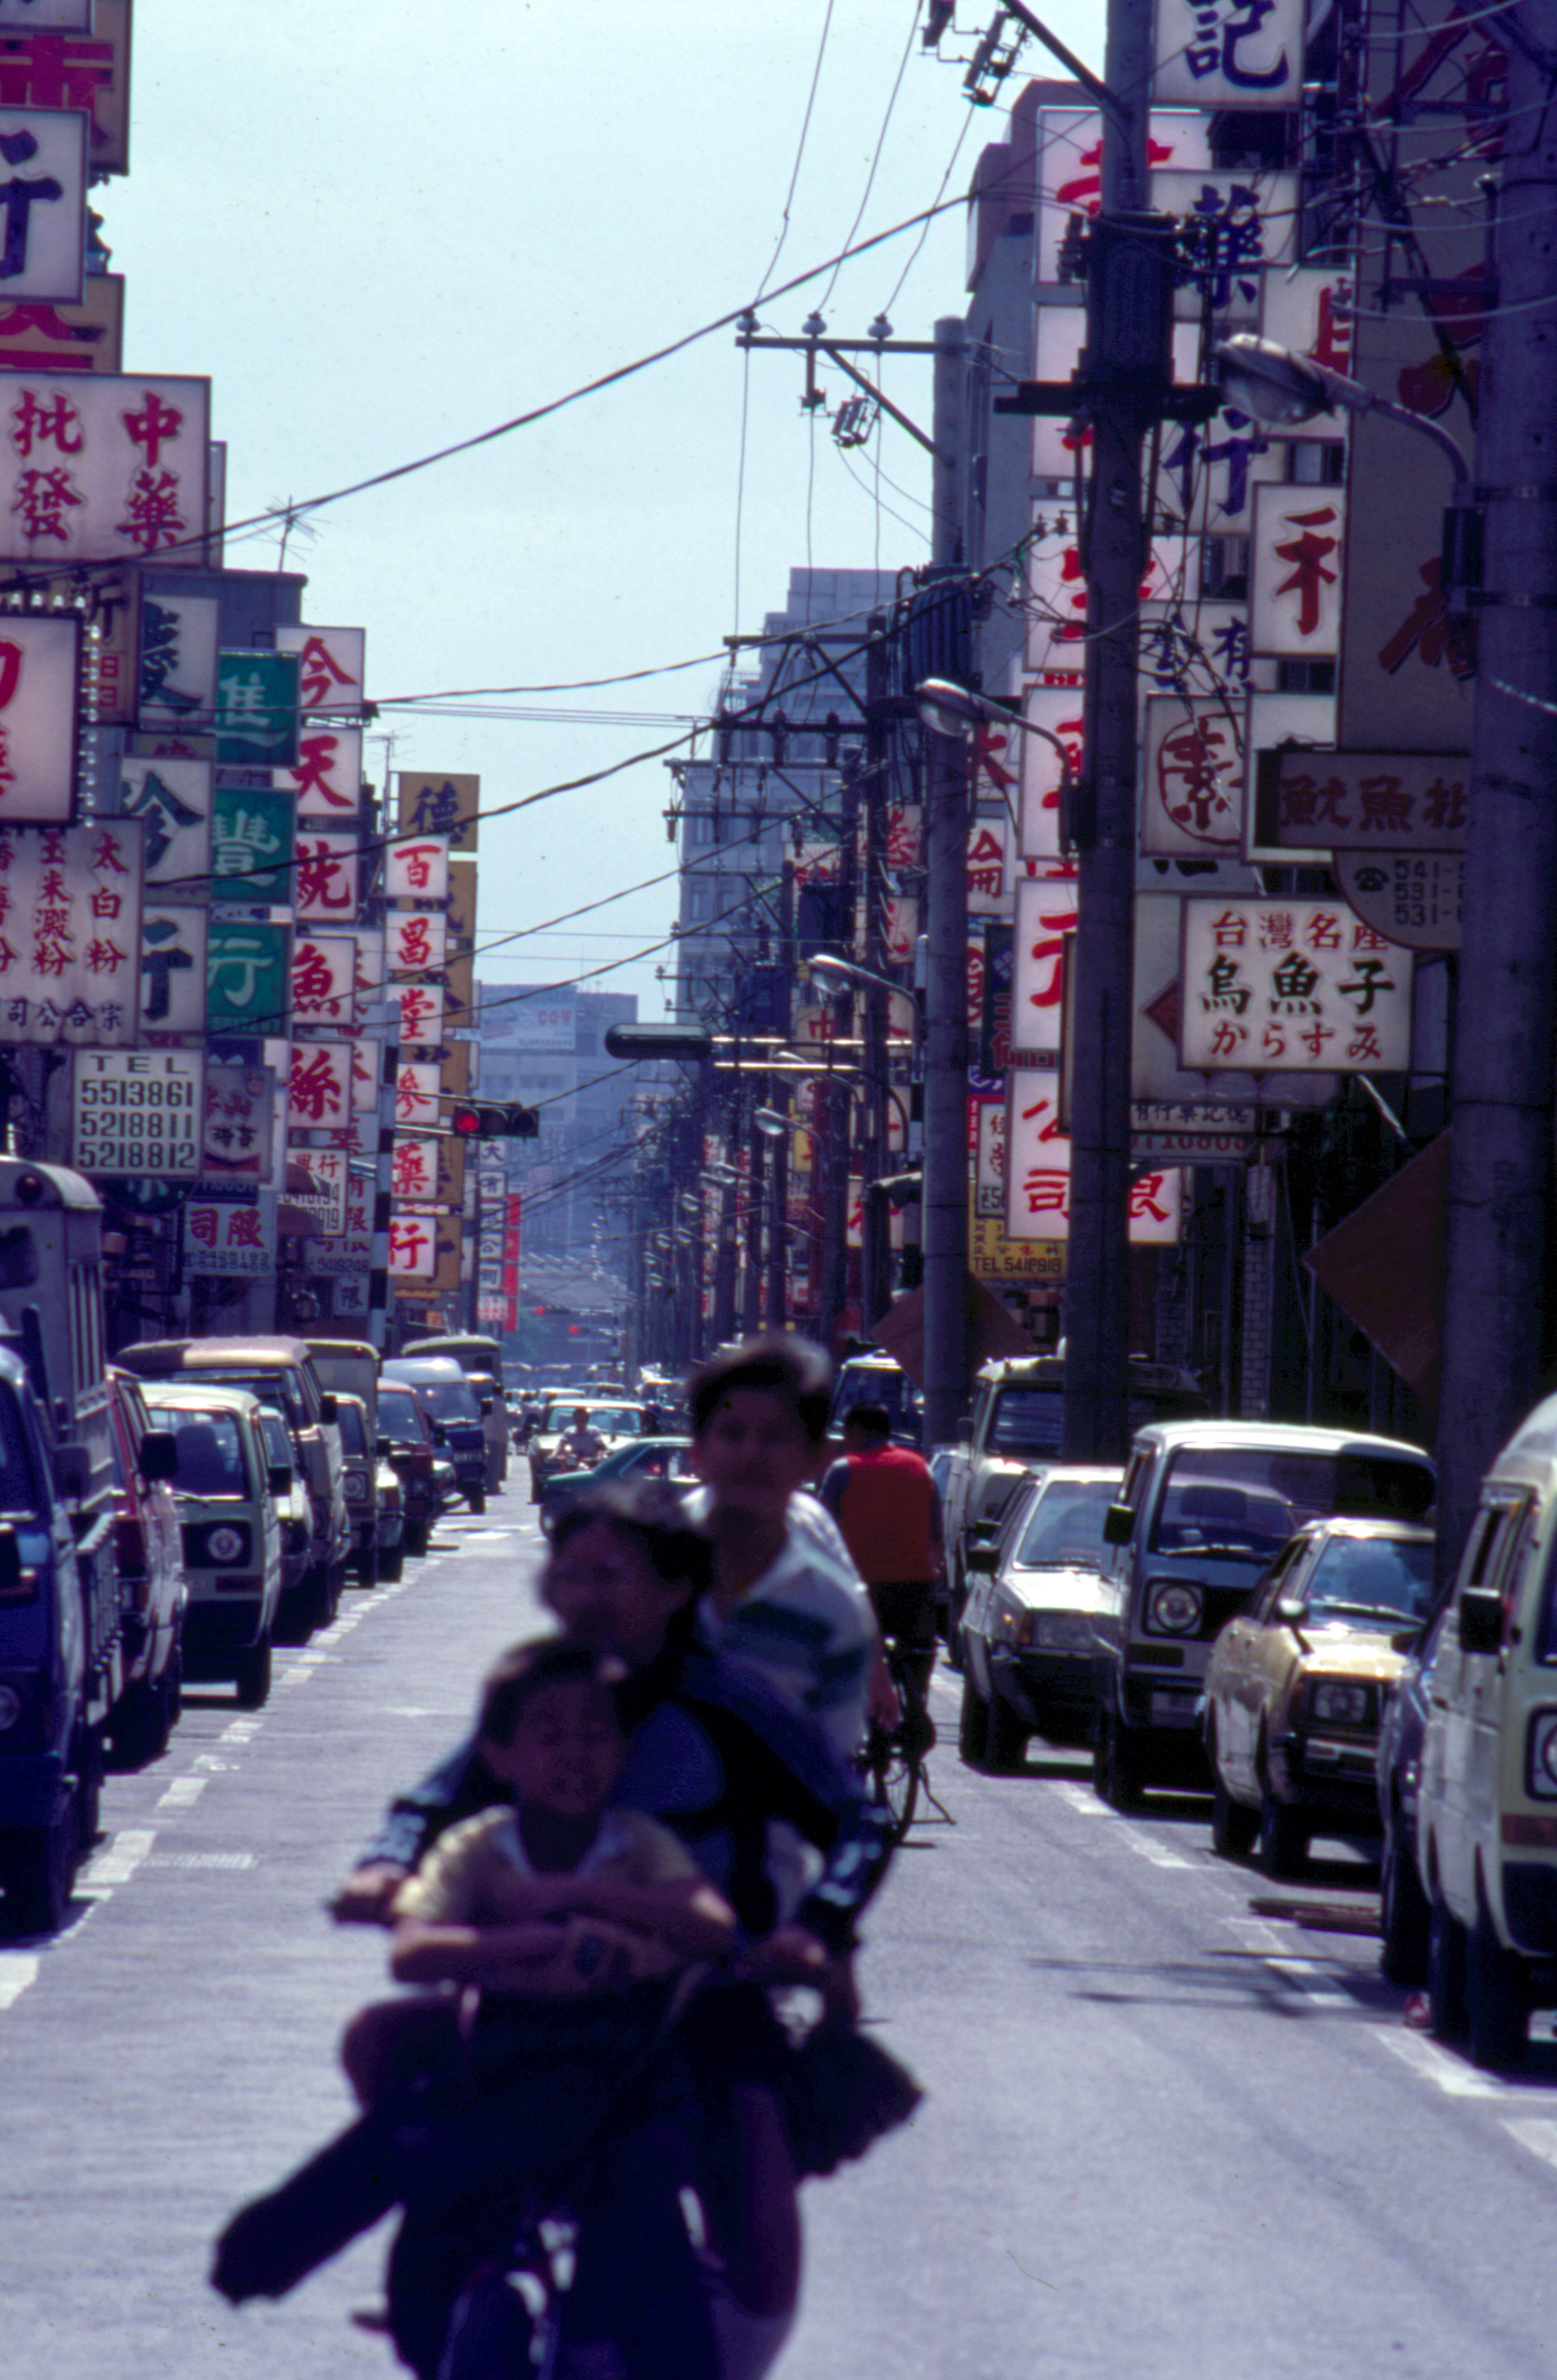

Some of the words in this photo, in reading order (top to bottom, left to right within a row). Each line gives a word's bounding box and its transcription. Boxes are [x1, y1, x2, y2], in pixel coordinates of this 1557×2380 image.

[11, 390, 83, 541] 批發
[116, 393, 186, 551] 中藥
[91, 832, 129, 973] 太白粉
[1202, 952, 1395, 1015] 烏魚子
[1211, 1021, 1381, 1060] からすみ
[90, 1055, 189, 1074] TEL
[82, 1080, 193, 1107] 5513861
[81, 1111, 193, 1139] 5218811
[79, 1142, 195, 1169] 5218812
